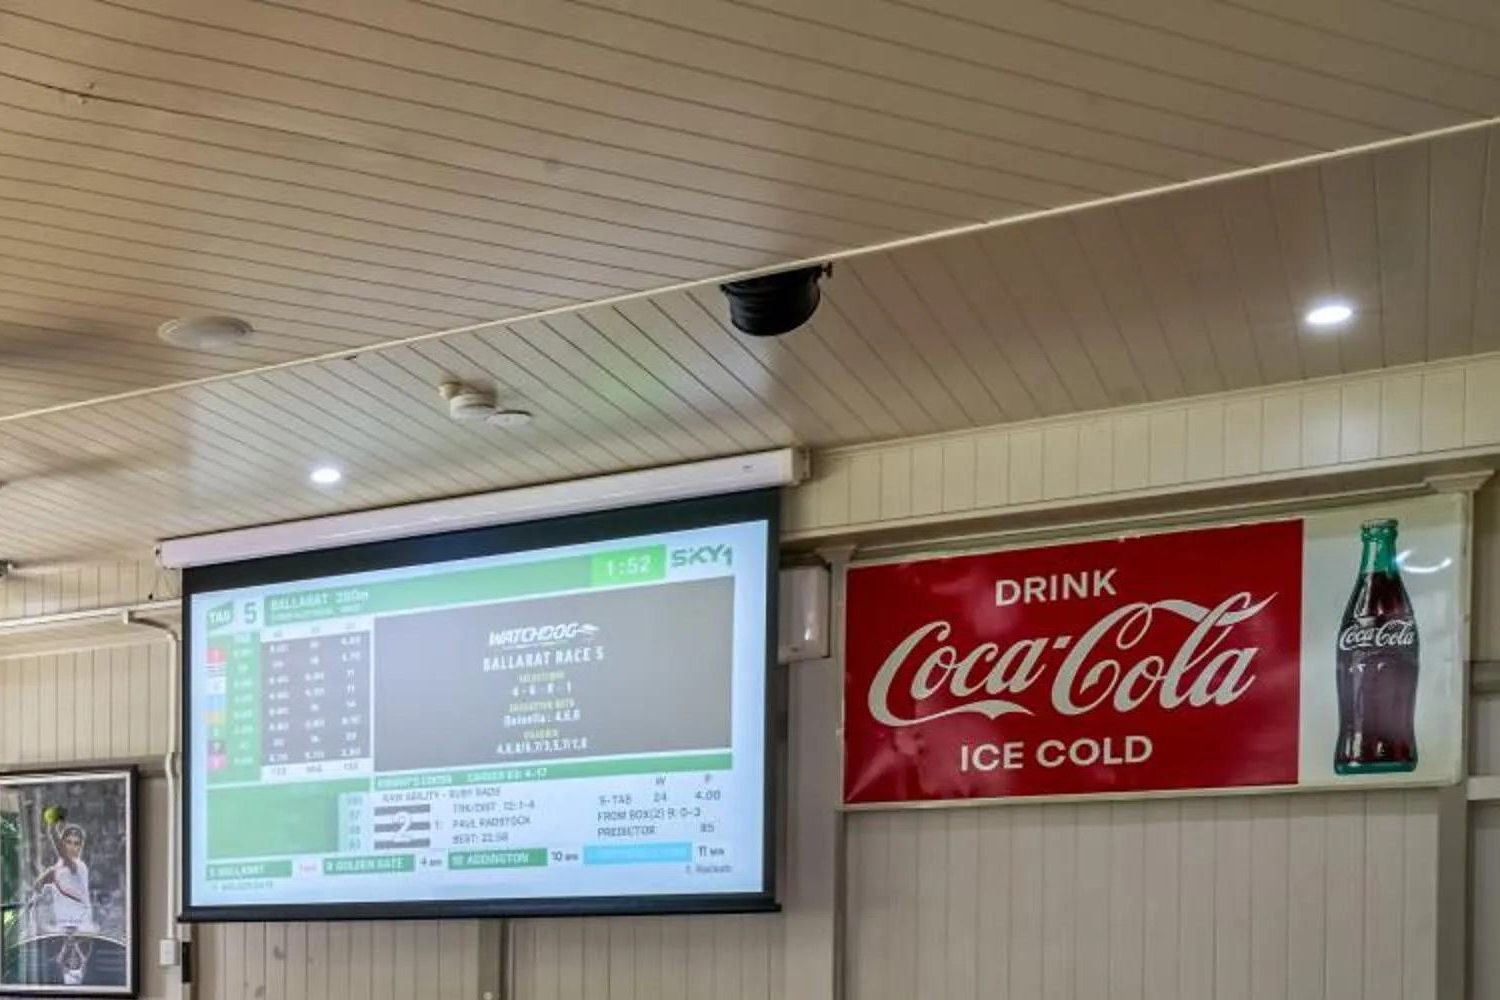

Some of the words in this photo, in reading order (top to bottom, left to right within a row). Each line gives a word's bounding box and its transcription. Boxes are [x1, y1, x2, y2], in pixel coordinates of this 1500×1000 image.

[607, 554, 652, 576] 1:52
[995, 568, 1118, 607] DRINK
[243, 602, 257, 624] 5
[483, 651, 551, 672] BALLARAT
[556, 647, 591, 665] RACE
[867, 590, 1279, 728] Coca-Cola
[960, 741, 1025, 771] ICE
[1036, 735, 1153, 769] COLD
[597, 811, 627, 822] FROM
